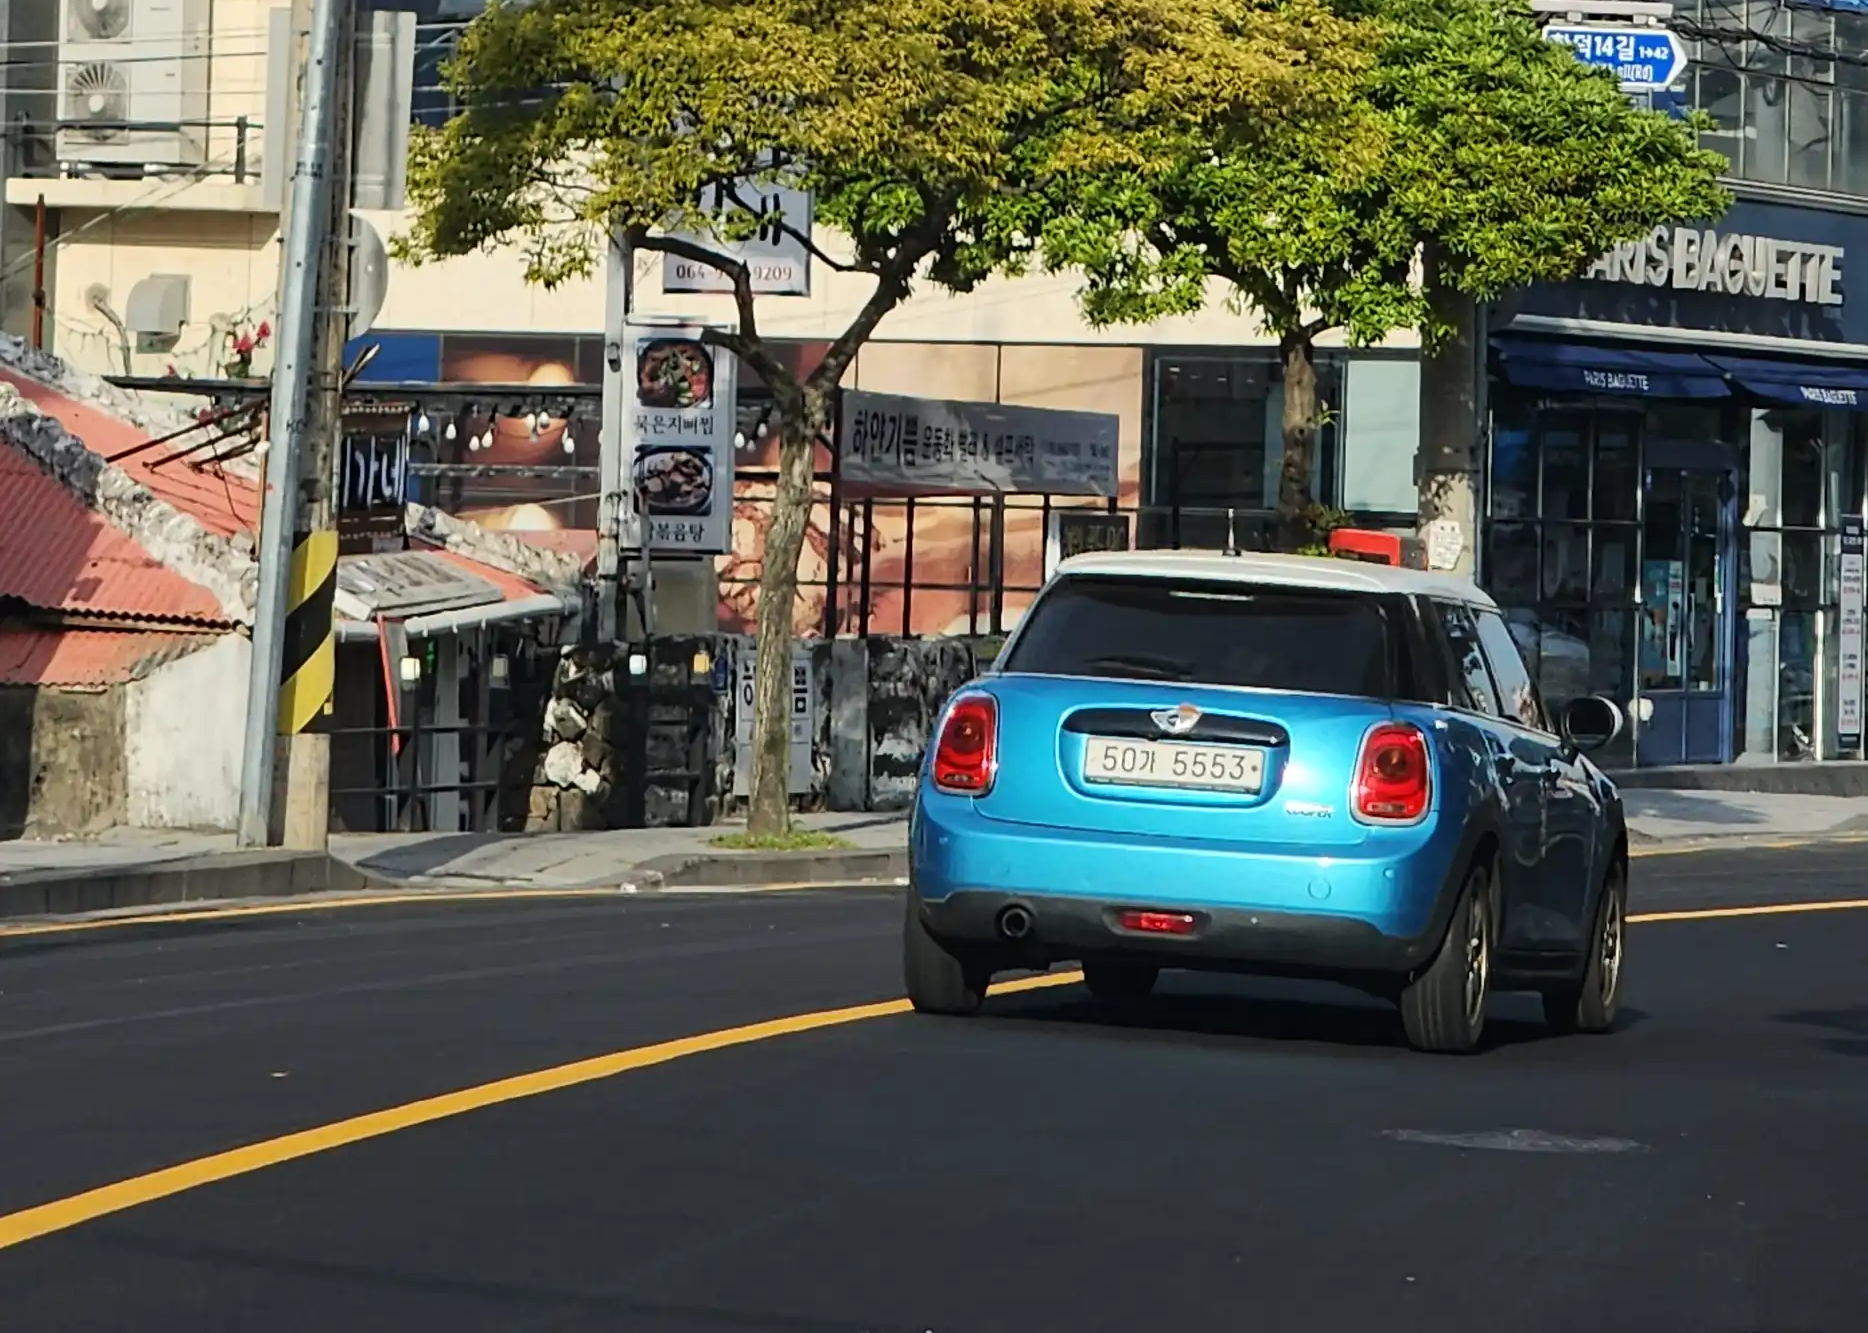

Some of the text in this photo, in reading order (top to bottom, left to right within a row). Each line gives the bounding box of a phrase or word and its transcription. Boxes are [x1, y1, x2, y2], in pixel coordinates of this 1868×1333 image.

[1672, 227, 1844, 304] BAGUETTE
[1584, 370, 1649, 391] PARIS BAGUETTE
[648, 522, 705, 543] 볶음탕
[1102, 746, 1246, 780] 50가 5553
